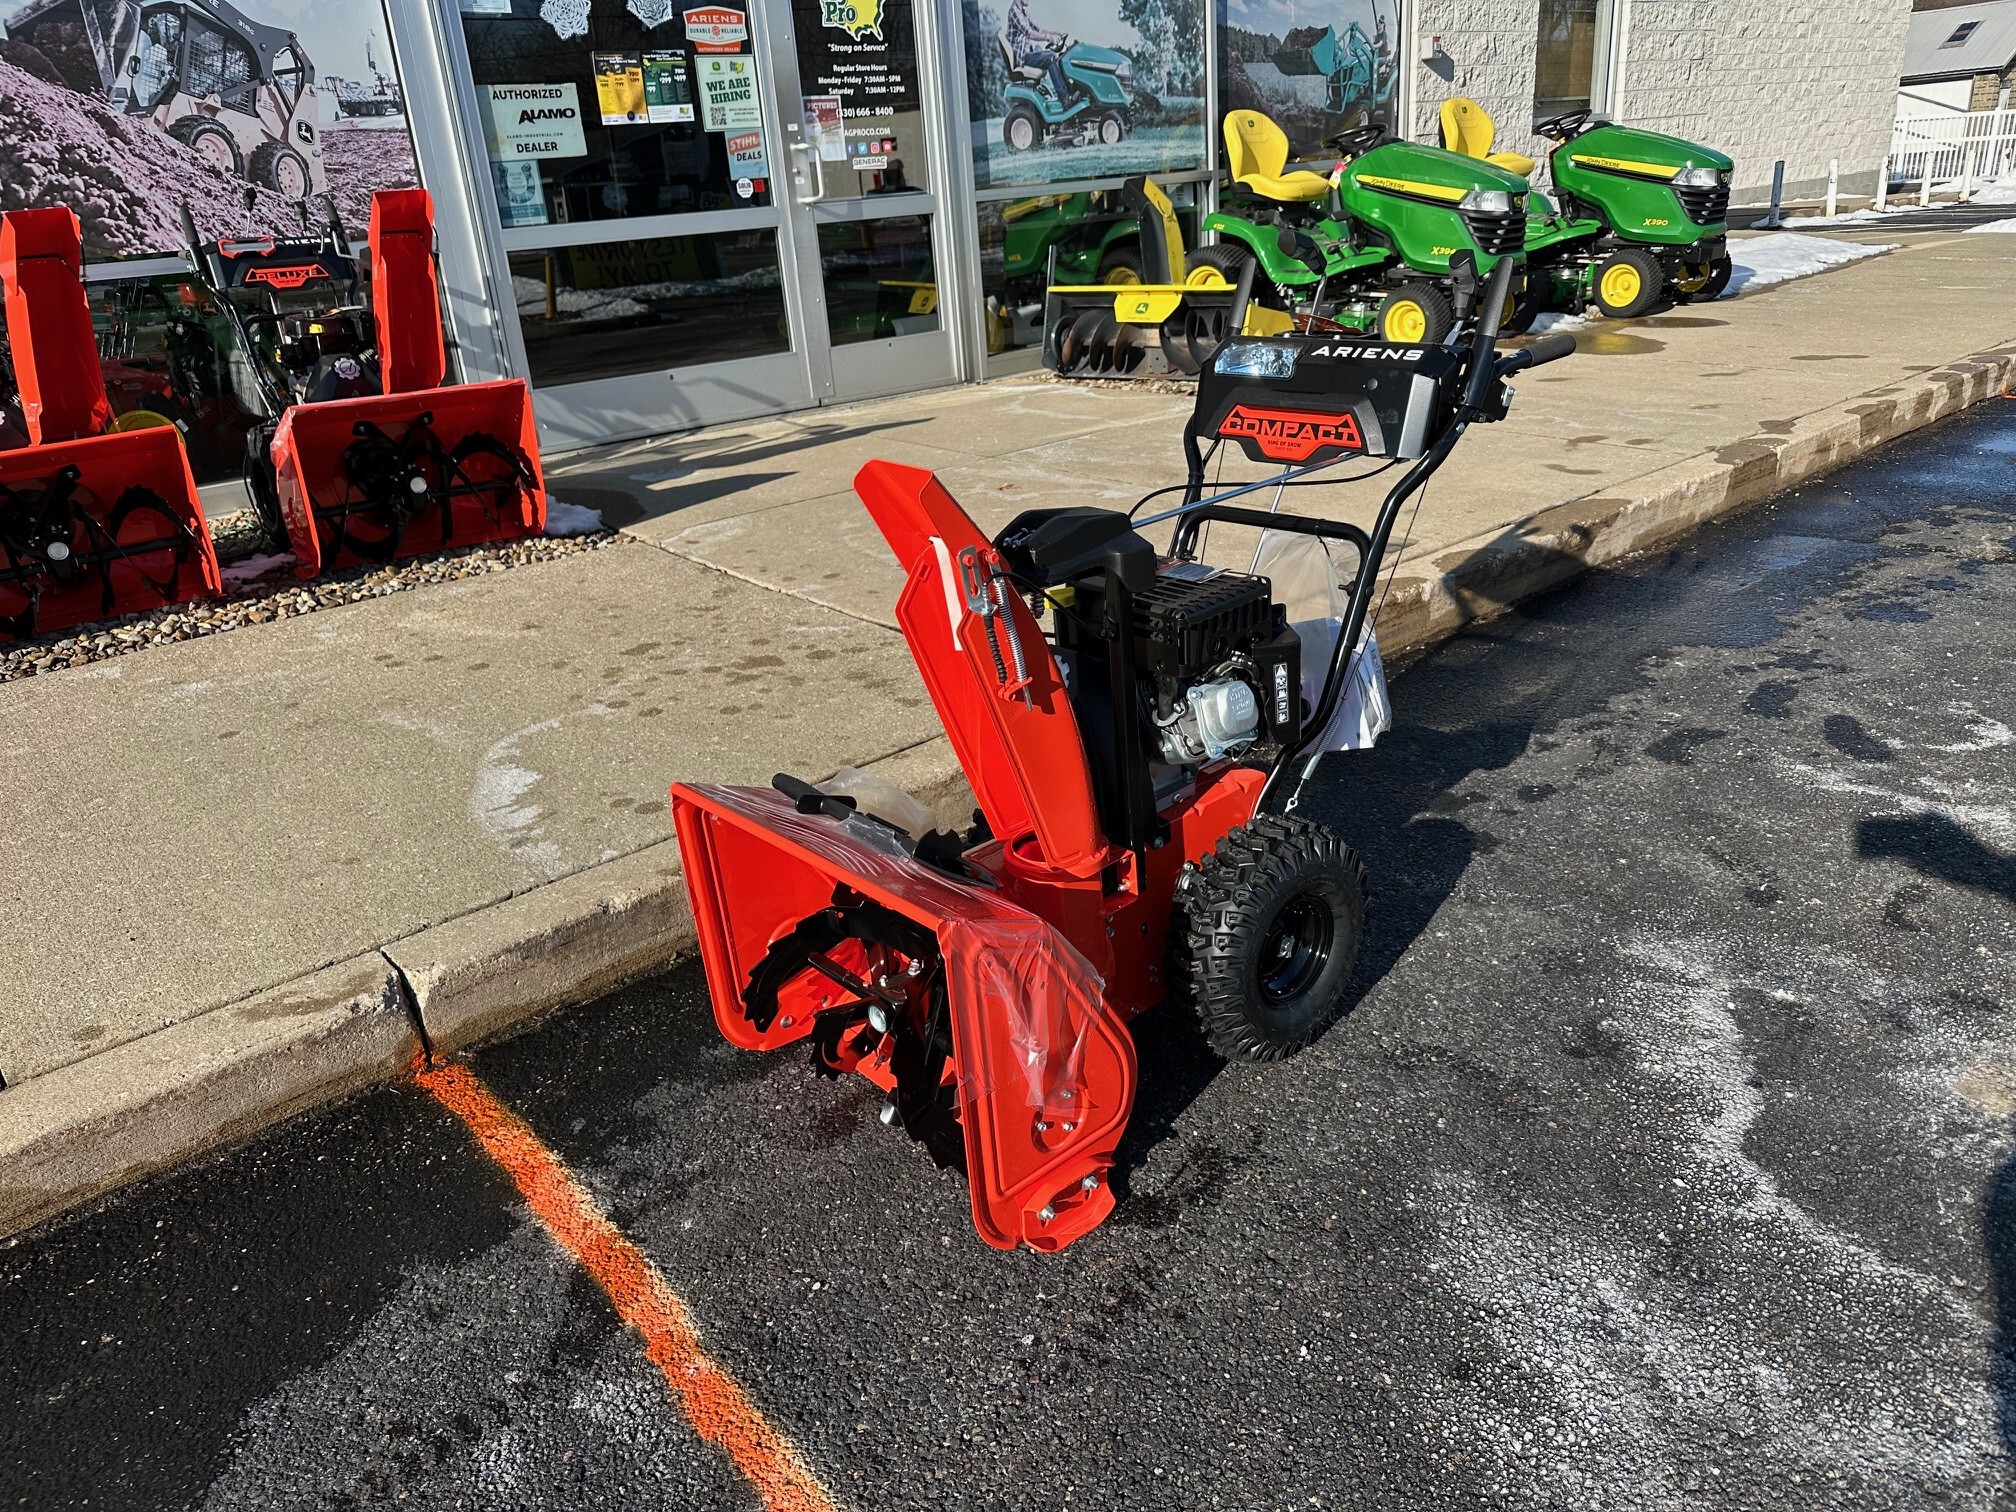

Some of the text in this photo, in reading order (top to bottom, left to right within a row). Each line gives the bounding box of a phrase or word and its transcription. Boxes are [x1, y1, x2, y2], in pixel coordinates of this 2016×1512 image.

[825, 1, 857, 23] Pro
[690, 15, 738, 23] ARIENS
[827, 43, 853, 54] "Strong
[863, 43, 889, 52] Service"
[833, 63, 888, 74] Regular Store Hours
[705, 77, 751, 92] WE ARE
[492, 89, 563, 100] AUTHORIZED
[709, 89, 751, 105] HIRING
[828, 87, 854, 96] Saturday
[518, 108, 576, 125] ALAMO
[856, 107, 870, 117] 666
[875, 106, 894, 116] 8400
[844, 127, 891, 137] AGPROCO.COM
[516, 141, 559, 154] DEALER
[730, 134, 760, 151] STIHL
[736, 151, 762, 162] DEALS
[853, 157, 886, 166] GENERAC
[1585, 157, 1621, 168] JOHN DEERE
[1371, 178, 1405, 190] JOHN DEERE
[1642, 218, 1669, 227] X390
[255, 269, 317, 281] DELUXE
[1311, 345, 1424, 361] ARIENS
[1224, 417, 1358, 442] COMPACT
